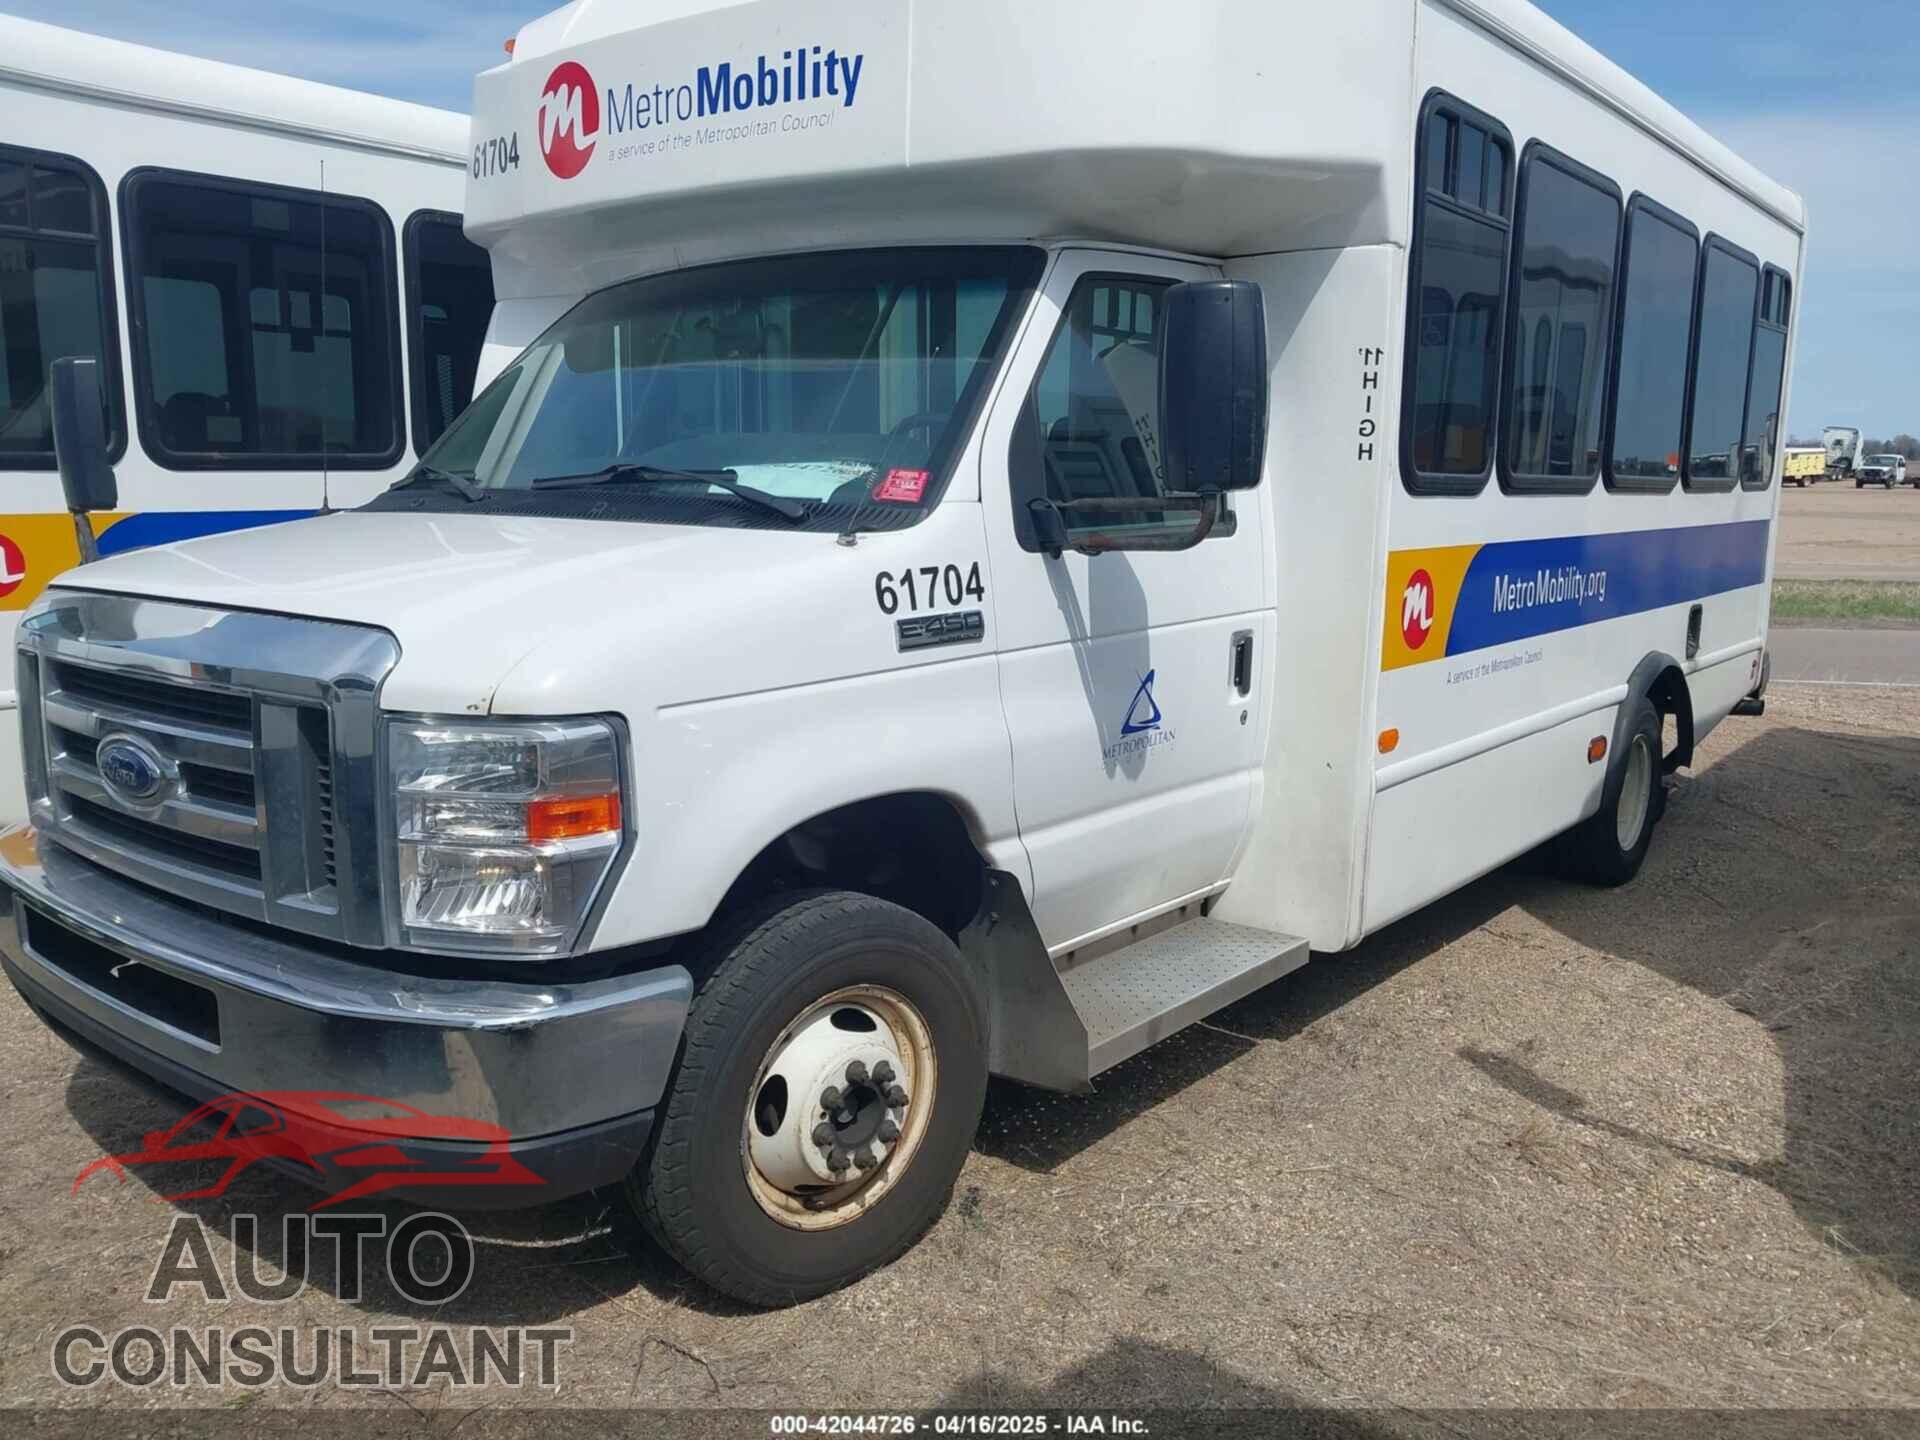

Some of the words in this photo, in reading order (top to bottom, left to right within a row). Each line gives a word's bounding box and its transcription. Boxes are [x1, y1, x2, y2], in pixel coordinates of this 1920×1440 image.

[473, 132, 520, 179] 61704
[608, 149, 616, 161] a
[617, 141, 655, 161] service
[658, 134, 672, 152] of
[673, 134, 692, 150] the
[696, 119, 777, 145] Metropolitan
[781, 109, 835, 132] Council
[875, 562, 985, 615] 61704
[1492, 566, 1607, 614] MetroMobility.org
[1103, 729, 1176, 760] METROPOLITAN
